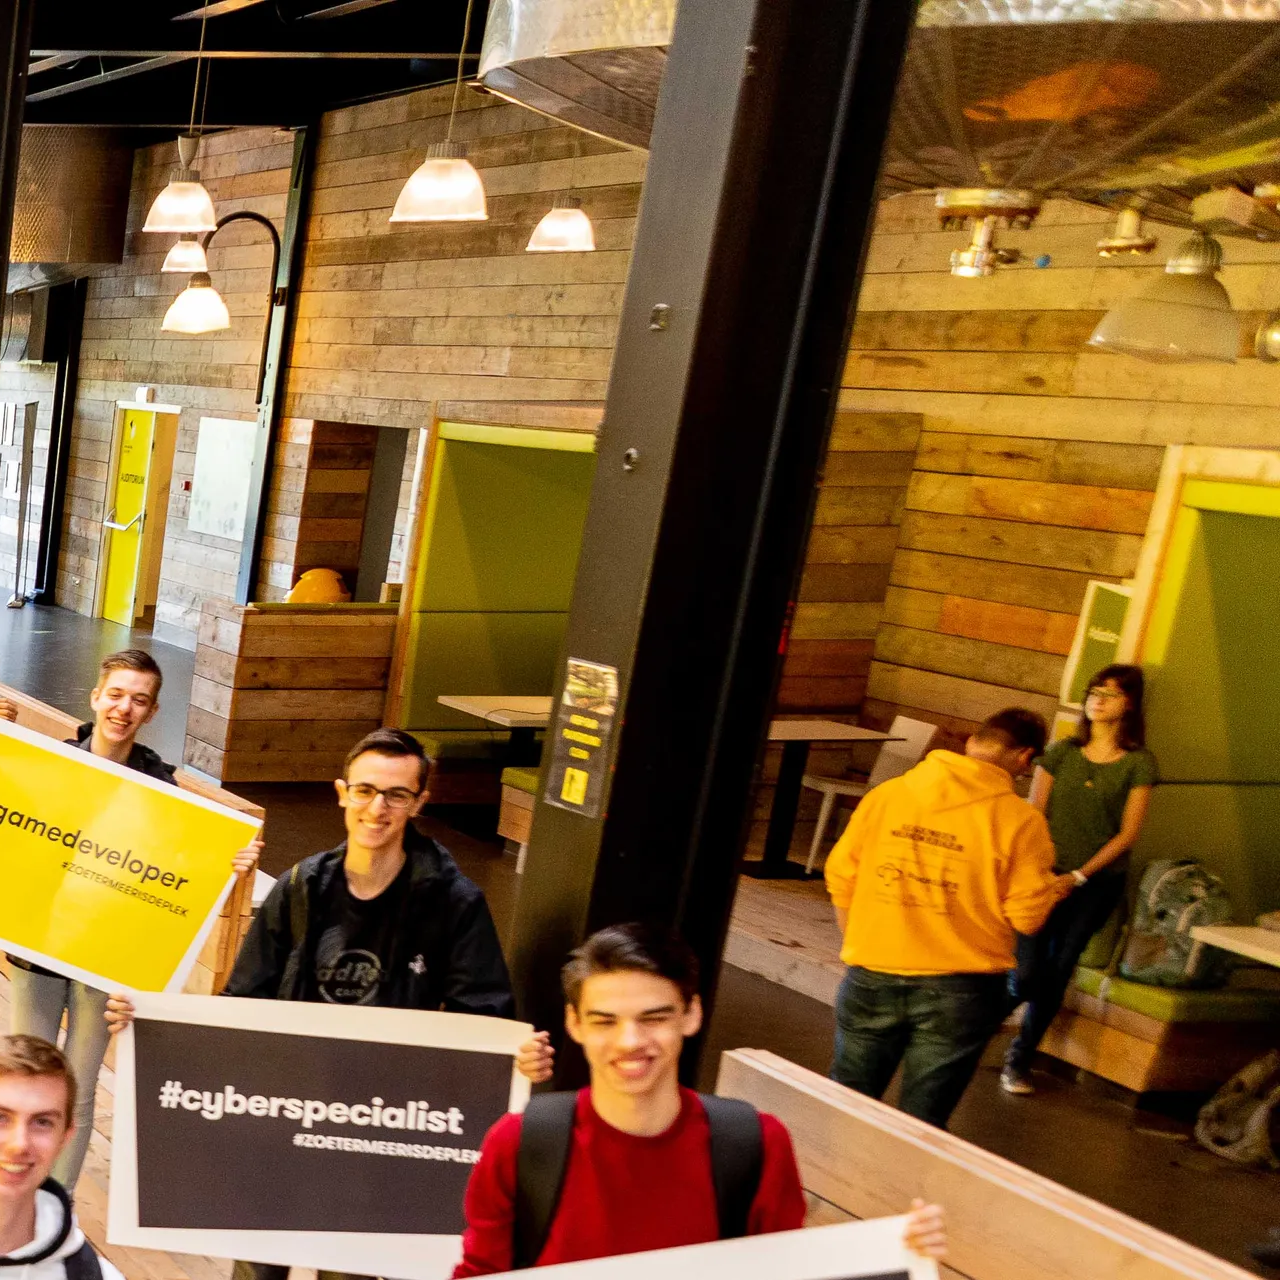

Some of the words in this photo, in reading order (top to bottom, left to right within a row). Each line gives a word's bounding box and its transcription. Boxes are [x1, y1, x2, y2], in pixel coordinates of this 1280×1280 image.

[61, 861, 188, 918] #ZOETERMEERISDEPLEK
[159, 1080, 464, 1135] #cyberspecialist
[293, 1133, 482, 1164] #ZOETERMEERISDEPLEK
